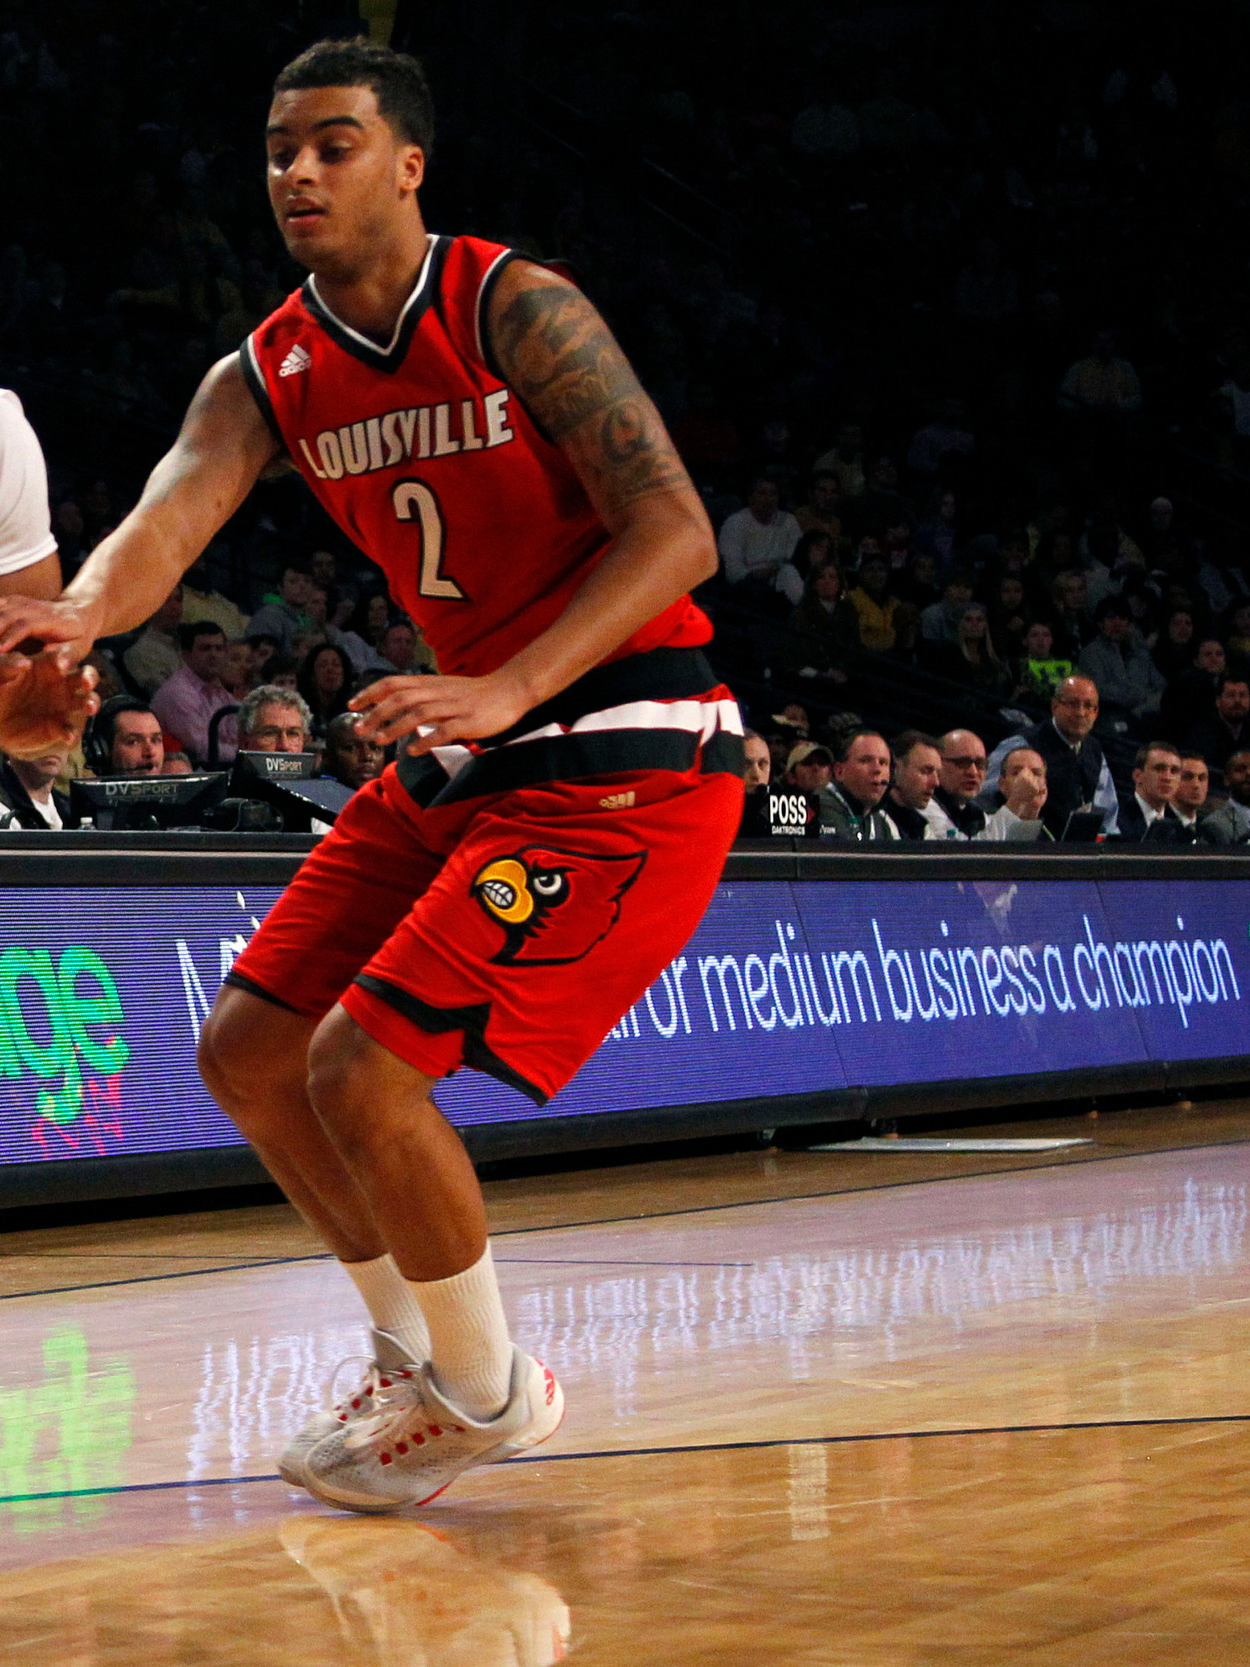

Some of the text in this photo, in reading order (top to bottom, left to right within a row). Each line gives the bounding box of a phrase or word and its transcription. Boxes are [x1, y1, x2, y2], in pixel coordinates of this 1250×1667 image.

[297, 388, 514, 480] LOUISVILLE
[391, 475, 468, 600] 2
[769, 794, 808, 825] POSS
[697, 919, 882, 1031] medium
[871, 918, 1045, 1023] business
[1043, 945, 1077, 1013] a
[1073, 913, 1241, 1029] champion
